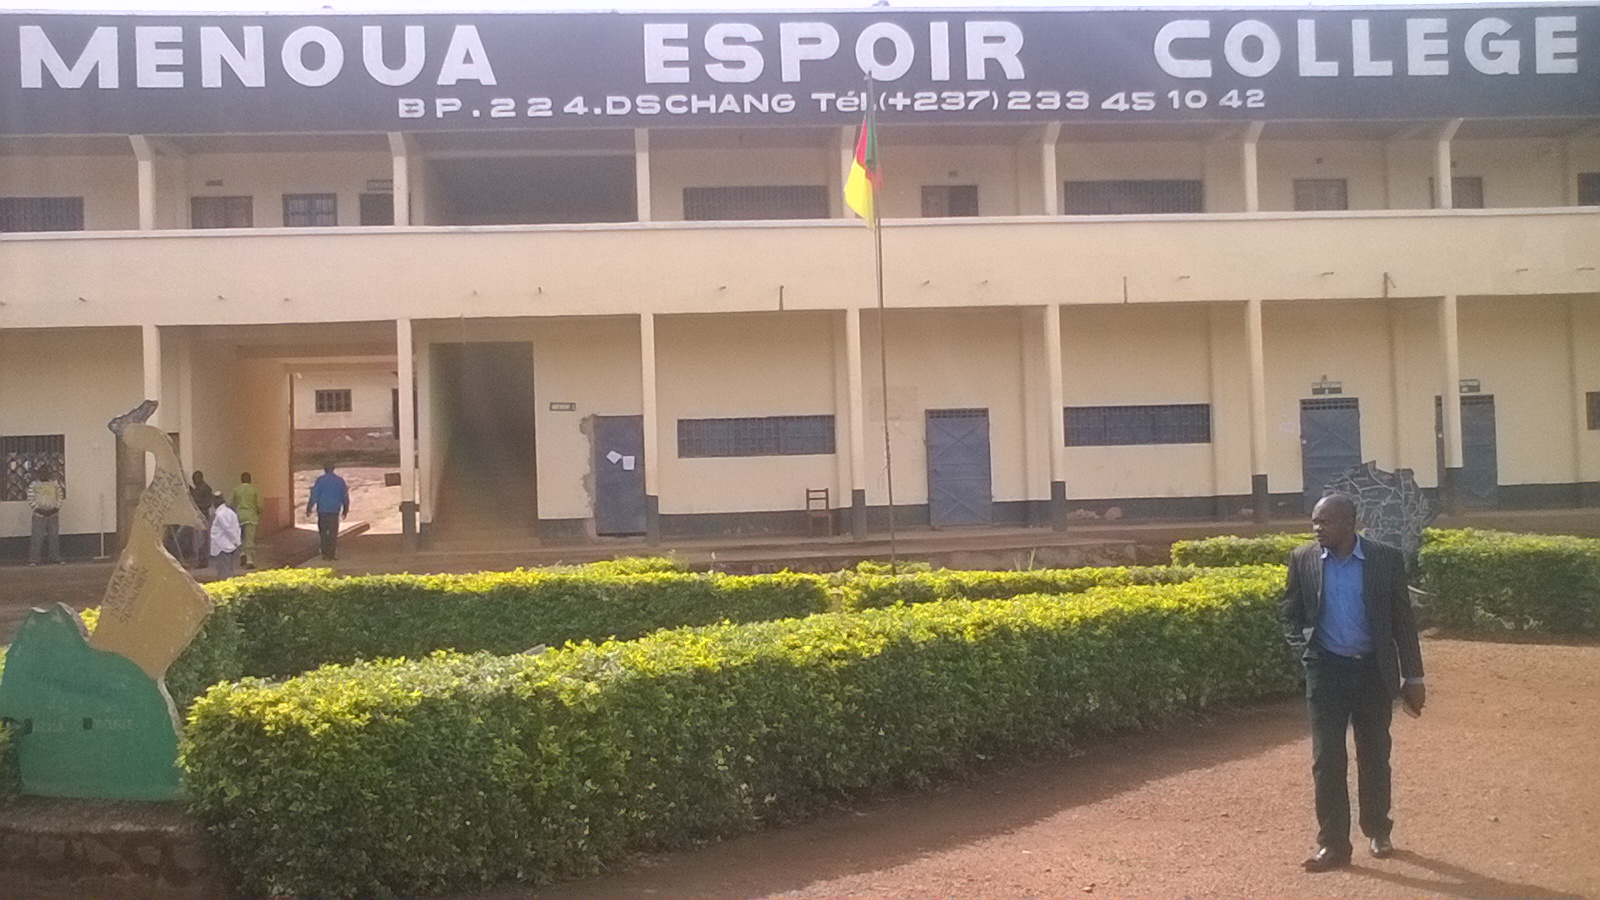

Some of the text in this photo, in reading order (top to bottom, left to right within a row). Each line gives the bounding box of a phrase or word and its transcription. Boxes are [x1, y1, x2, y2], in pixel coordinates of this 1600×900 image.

[20, 16, 1576, 88] MENOUA ESPOIR COLLEGE
[1008, 90, 1089, 110] 233
[1102, 91, 1155, 111] 45
[1168, 89, 1207, 108] 10
[1220, 88, 1264, 108] 42
